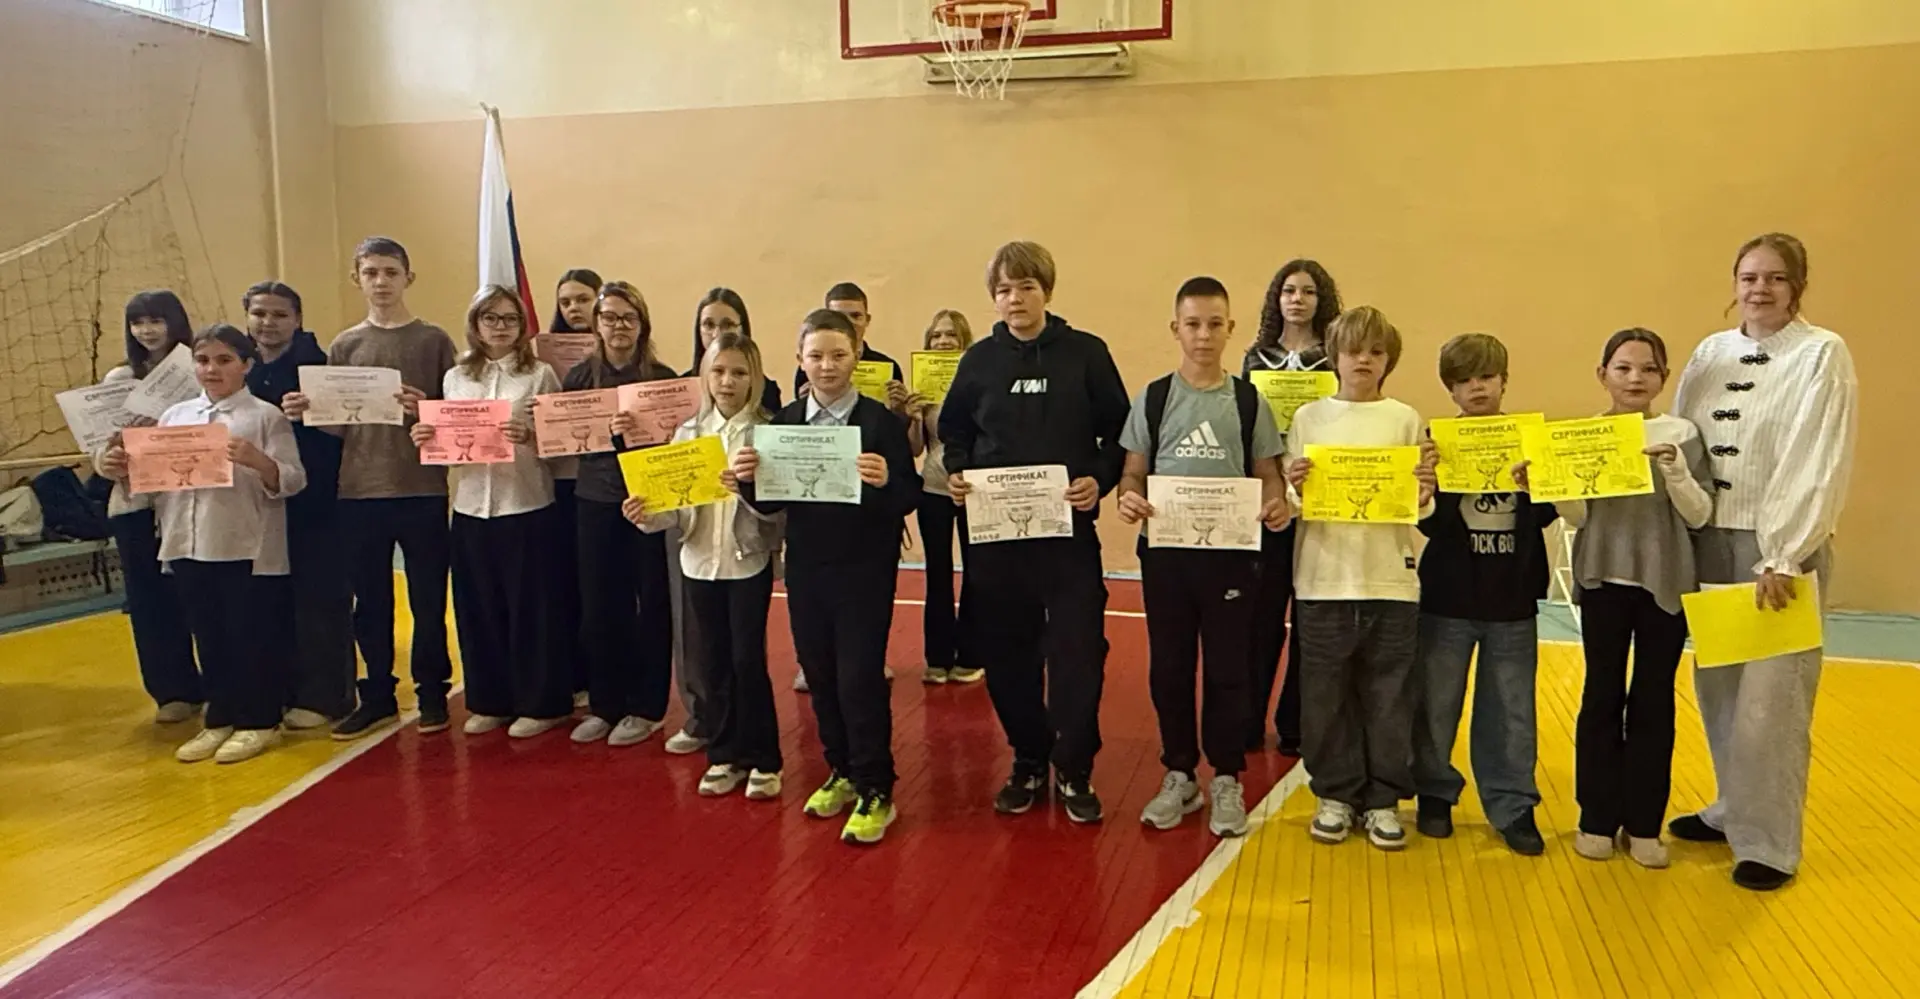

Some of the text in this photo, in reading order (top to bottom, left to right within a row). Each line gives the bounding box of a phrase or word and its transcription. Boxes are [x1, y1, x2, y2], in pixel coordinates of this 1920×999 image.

[1458, 423, 1517, 436] СЕРТИФИКАТ
[1552, 425, 1614, 440] СЕРТИФИКАТ
[1175, 445, 1226, 460] adidas
[1331, 455, 1392, 464] СЕРТИФИКАТ
[987, 470, 1048, 484] СЕРТИФИКАТ
[1175, 486, 1235, 495] СЕРТИФИКАТ
[1470, 533, 1497, 554] OCK
